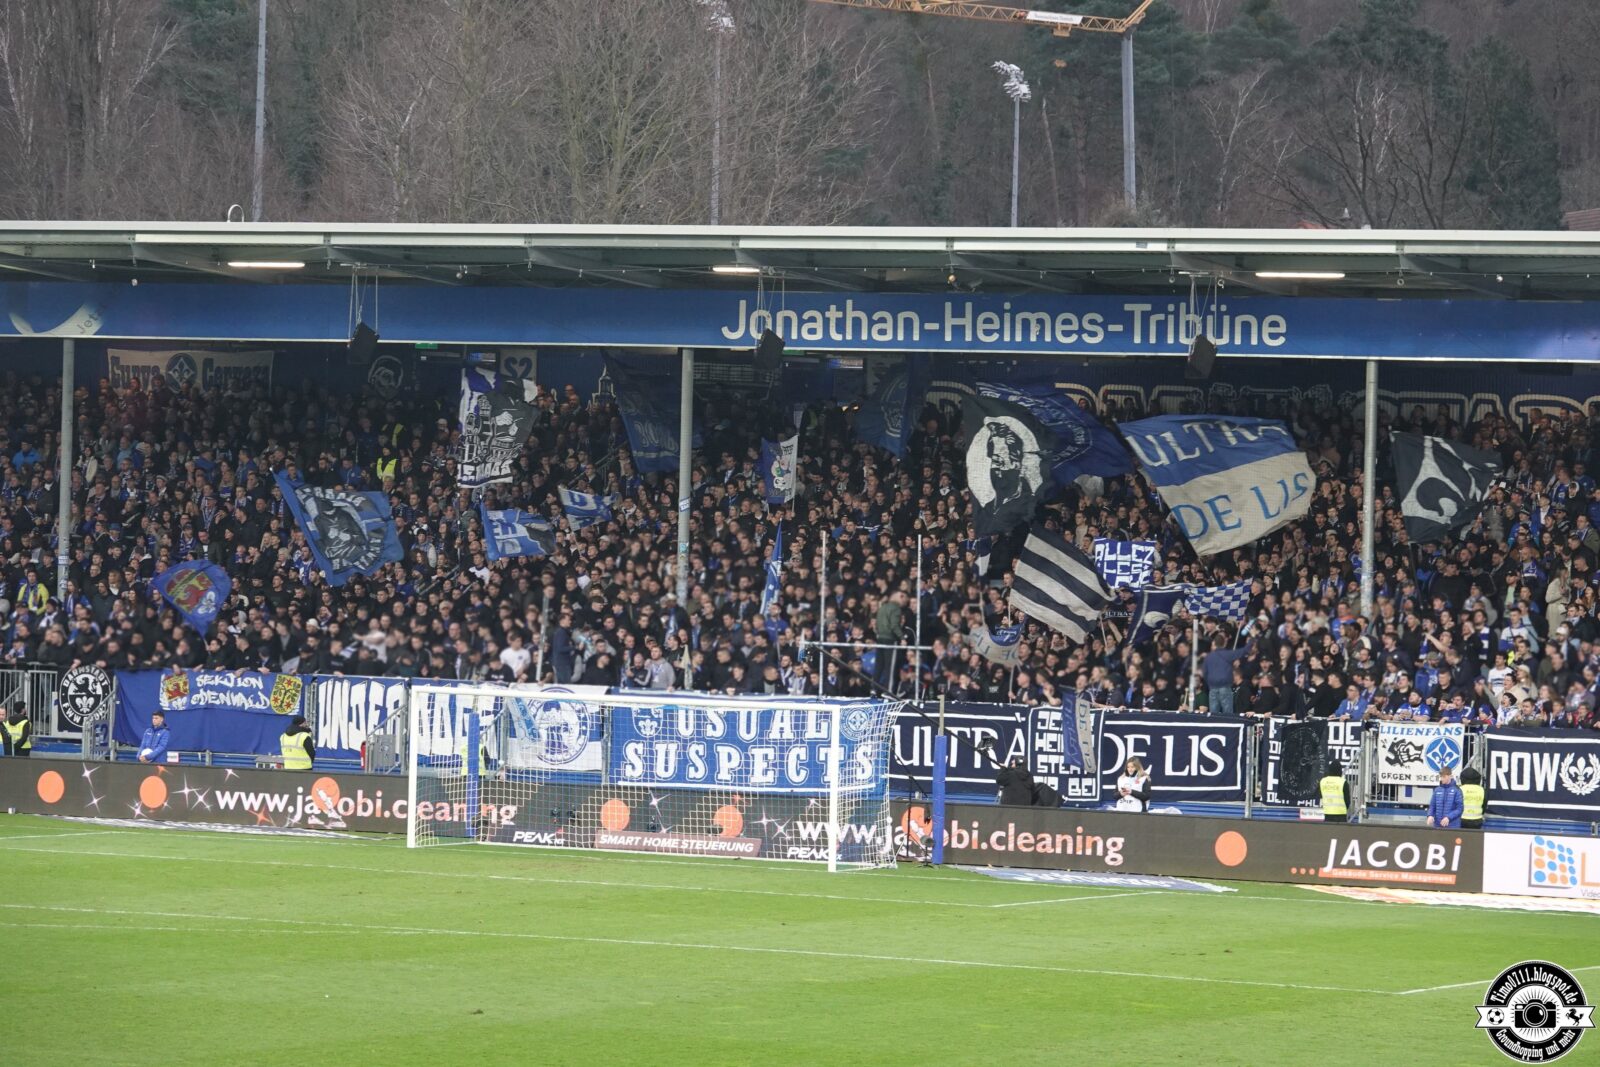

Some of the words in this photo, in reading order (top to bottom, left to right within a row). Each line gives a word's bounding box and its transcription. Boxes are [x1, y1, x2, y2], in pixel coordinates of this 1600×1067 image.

[721, 299, 1287, 346] Jonathan-Heimes-Tribüne
[1171, 494, 1242, 540] DE
[1095, 542, 1154, 566] ALLEZ
[62, 665, 109, 688] DARMSTADT
[676, 704, 829, 741] USUAL
[1380, 726, 1463, 737] LILIENFANS
[623, 739, 874, 785] SUSPECTS
[1170, 734, 1227, 777] LIS
[1490, 750, 1560, 792] ROW
[1381, 772, 1412, 781] GEGEN
[600, 835, 641, 847] SMART
[643, 837, 679, 848] HOME
[679, 838, 755, 853] STEUERUNG
